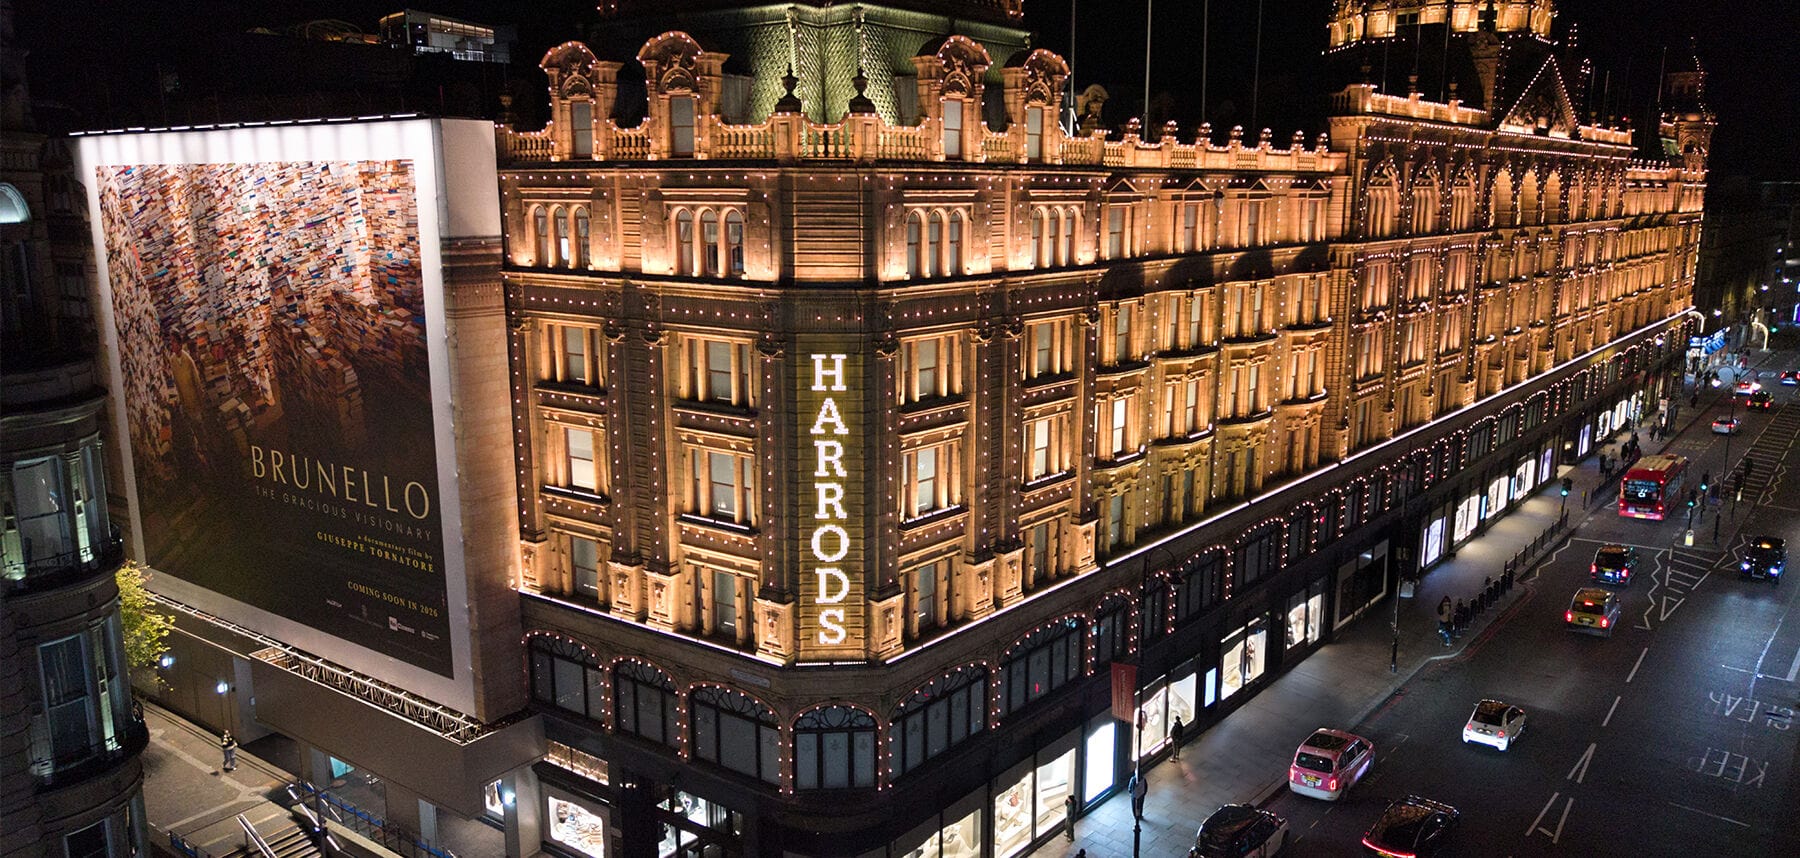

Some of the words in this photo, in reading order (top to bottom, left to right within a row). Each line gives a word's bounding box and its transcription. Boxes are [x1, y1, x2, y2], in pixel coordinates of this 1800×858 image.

[251, 445, 430, 520] BRUNELLO
[810, 354, 850, 645] HARRODS
[256, 485, 276, 499] THE
[283, 493, 347, 519] GRACIOUS
[355, 512, 431, 541] VISIONARY
[316, 531, 365, 553] GIUSEPPE
[369, 546, 434, 573] TORNATORE
[363, 535, 406, 553] documentary
[408, 547, 422, 558] film
[424, 551, 433, 561] by
[347, 581, 381, 599] COMING
[382, 592, 406, 607] SOON
[408, 600, 417, 610] IN
[420, 604, 439, 618] 2026
